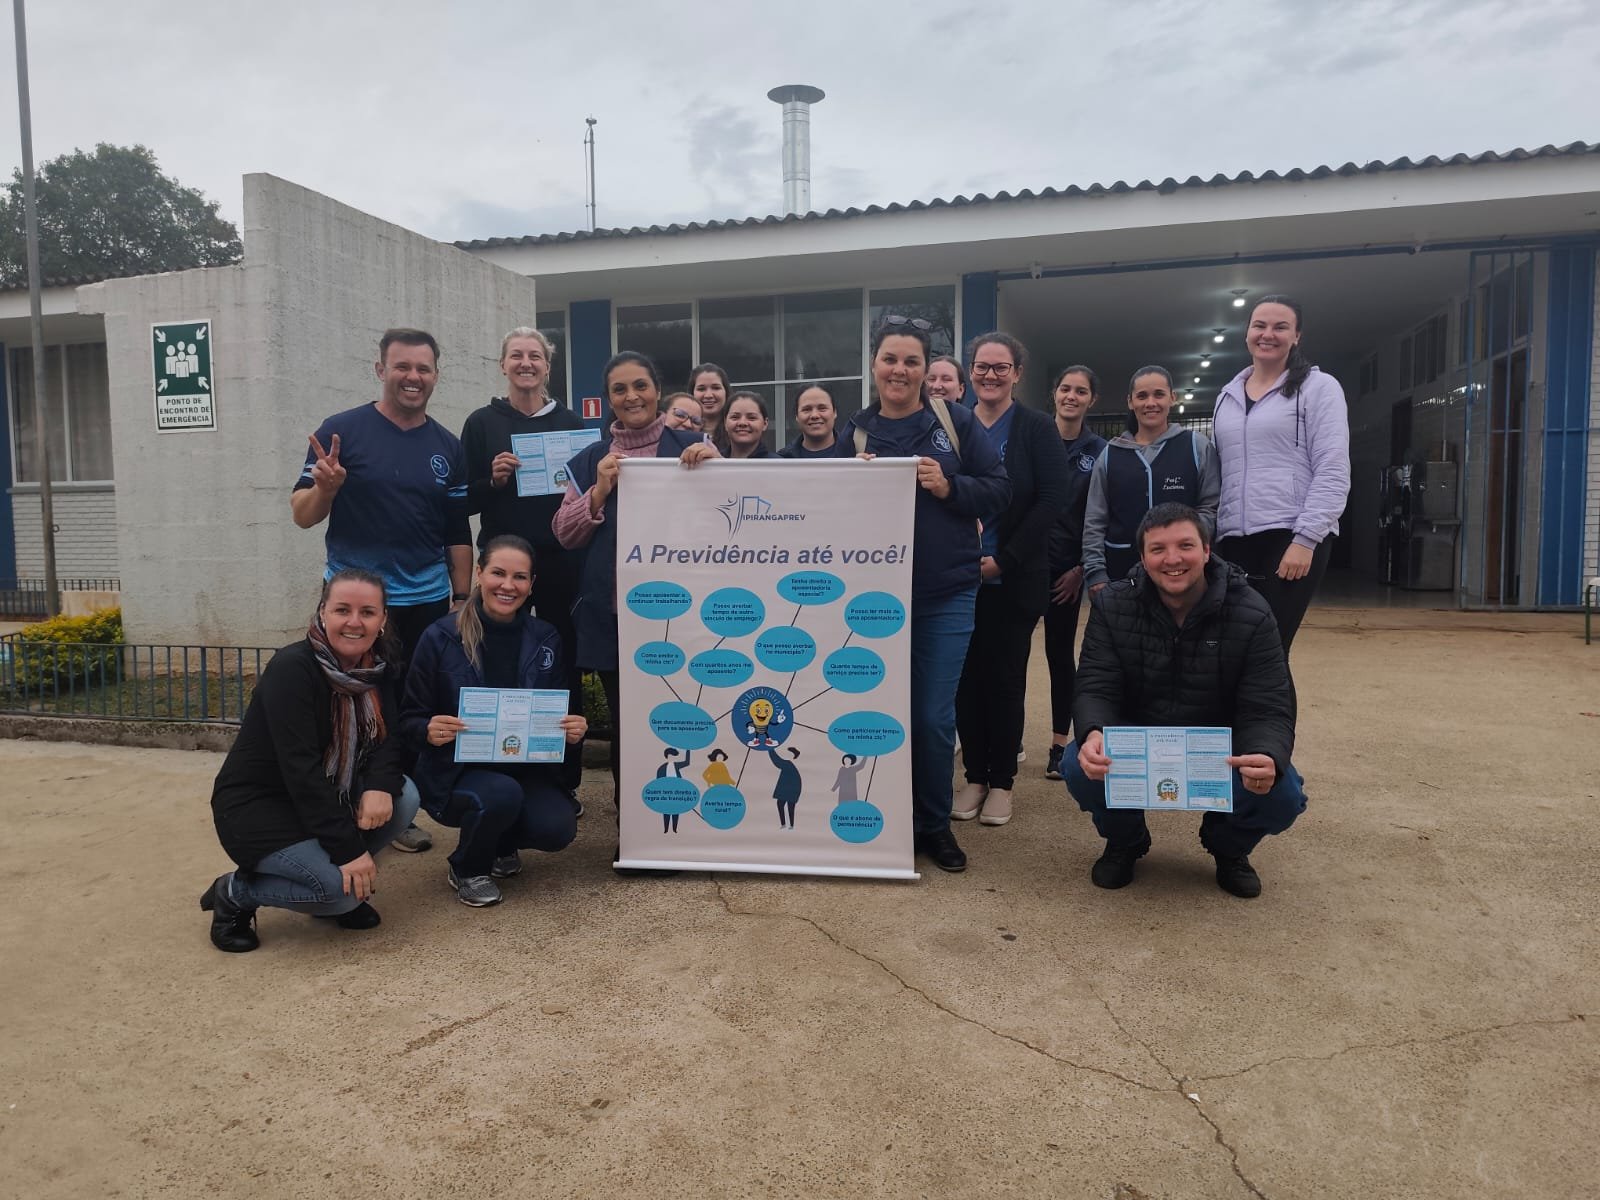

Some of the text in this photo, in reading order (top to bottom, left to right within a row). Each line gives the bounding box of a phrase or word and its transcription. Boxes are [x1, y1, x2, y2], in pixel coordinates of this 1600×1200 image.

[166, 398, 190, 406] PONTO
[742, 514, 806, 522] IPIRANGAPREV
[625, 544, 907, 564] A Previdência até você!
